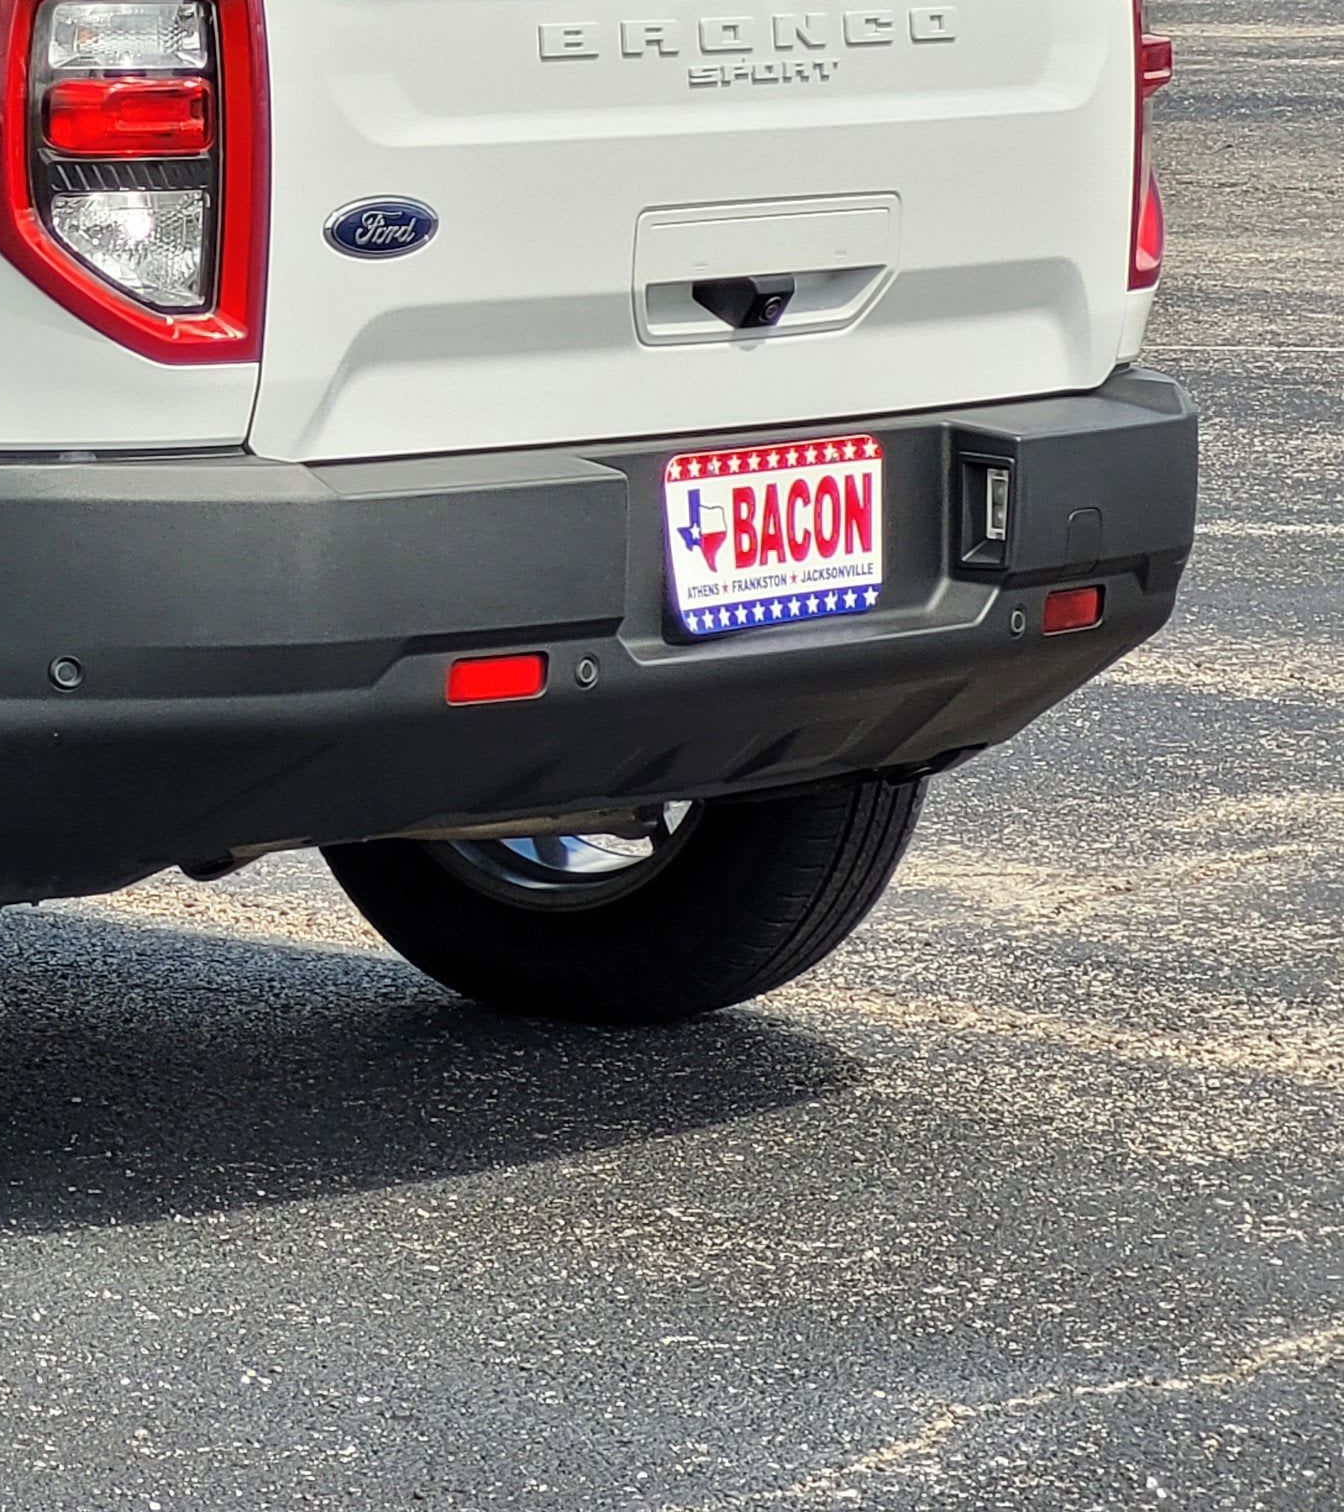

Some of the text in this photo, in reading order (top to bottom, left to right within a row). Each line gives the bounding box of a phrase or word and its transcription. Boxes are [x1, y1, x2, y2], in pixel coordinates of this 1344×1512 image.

[538, 6, 957, 62] BRONCO
[688, 58, 841, 88] SPORT
[355, 210, 417, 245] Ford
[732, 472, 873, 570] BACON
[687, 562, 874, 599] ATHENS FRANKSTON JACKSONVILLE
